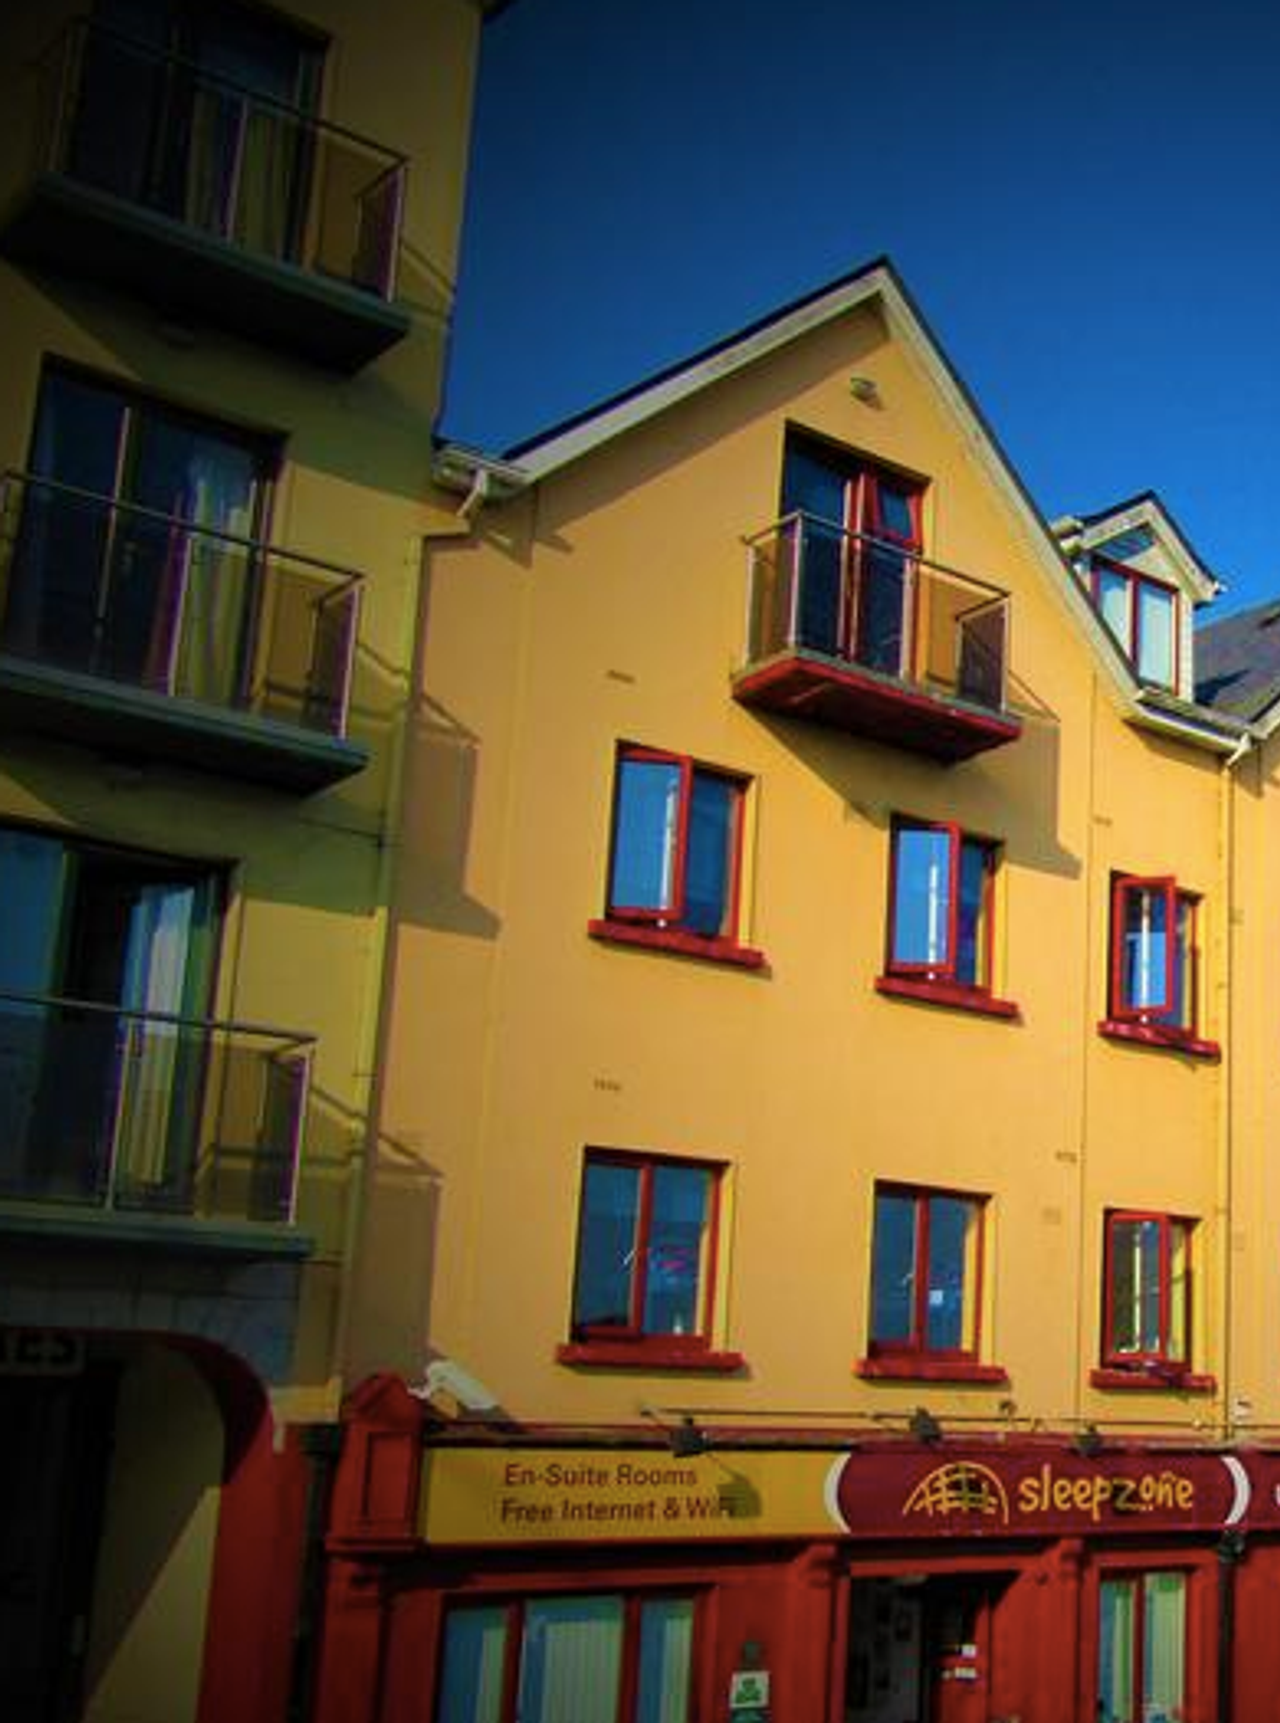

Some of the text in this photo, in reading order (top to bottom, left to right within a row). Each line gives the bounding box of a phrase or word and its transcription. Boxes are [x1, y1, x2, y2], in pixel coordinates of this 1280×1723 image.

[504, 1463, 698, 1488] En-Suite Rooms
[1018, 1463, 1194, 1522] sleepzone
[501, 1498, 554, 1524] Free
[562, 1496, 656, 1522] Internet
[663, 1497, 681, 1520] &
